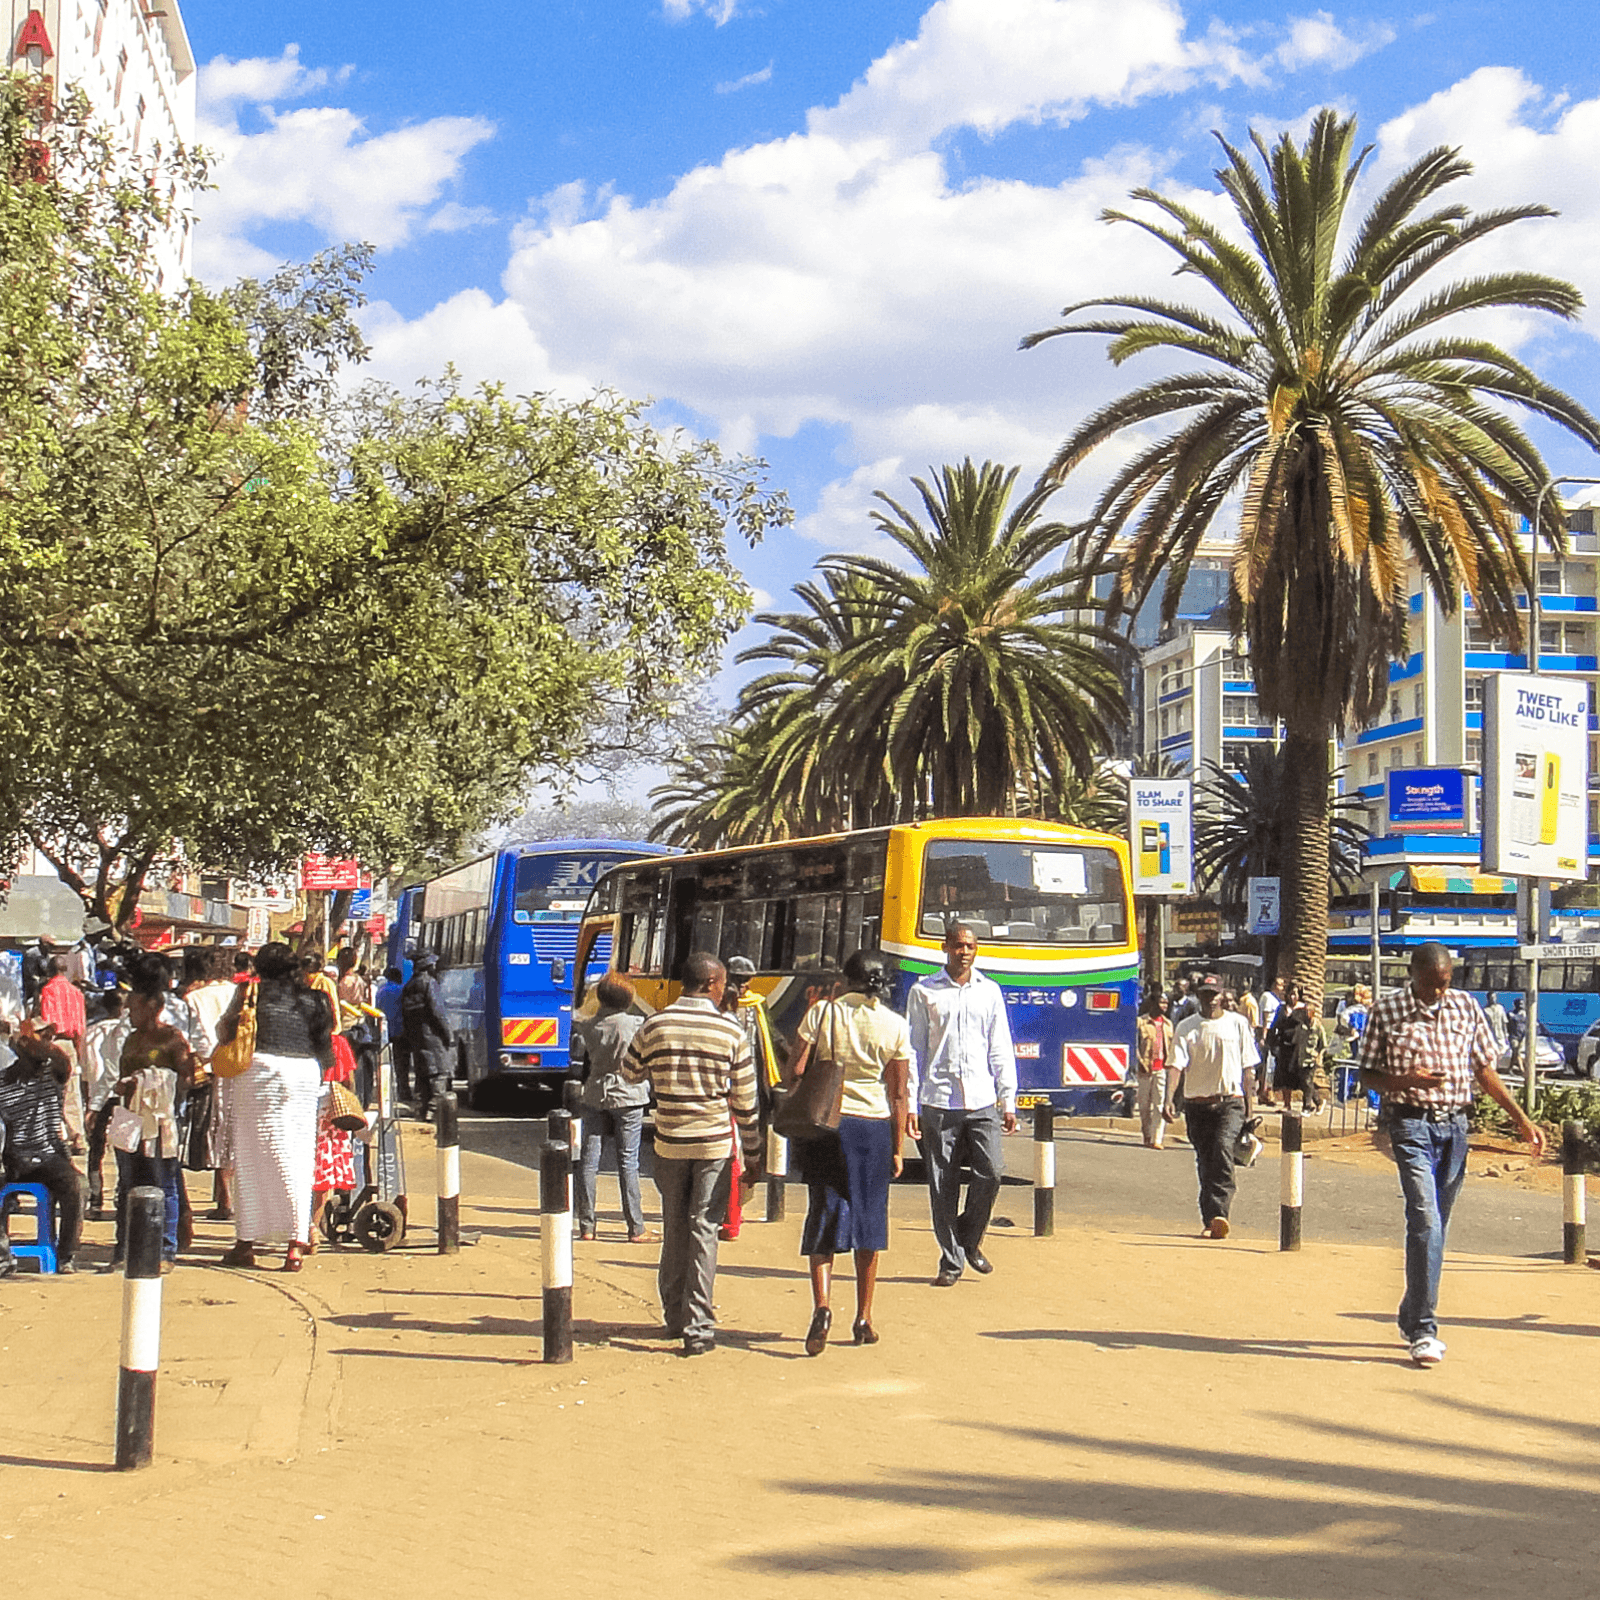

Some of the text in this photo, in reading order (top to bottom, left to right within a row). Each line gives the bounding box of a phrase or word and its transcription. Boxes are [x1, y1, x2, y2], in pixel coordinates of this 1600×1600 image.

[1517, 689, 1562, 709] TWEET
[1516, 704, 1545, 720] AND
[1549, 709, 1579, 727] LIKE
[1136, 790, 1161, 798] SLAM
[1137, 799, 1182, 807] TO SHARE
[1542, 945, 1596, 956] SHORT STREET
[1003, 991, 1056, 1005] SUZU
